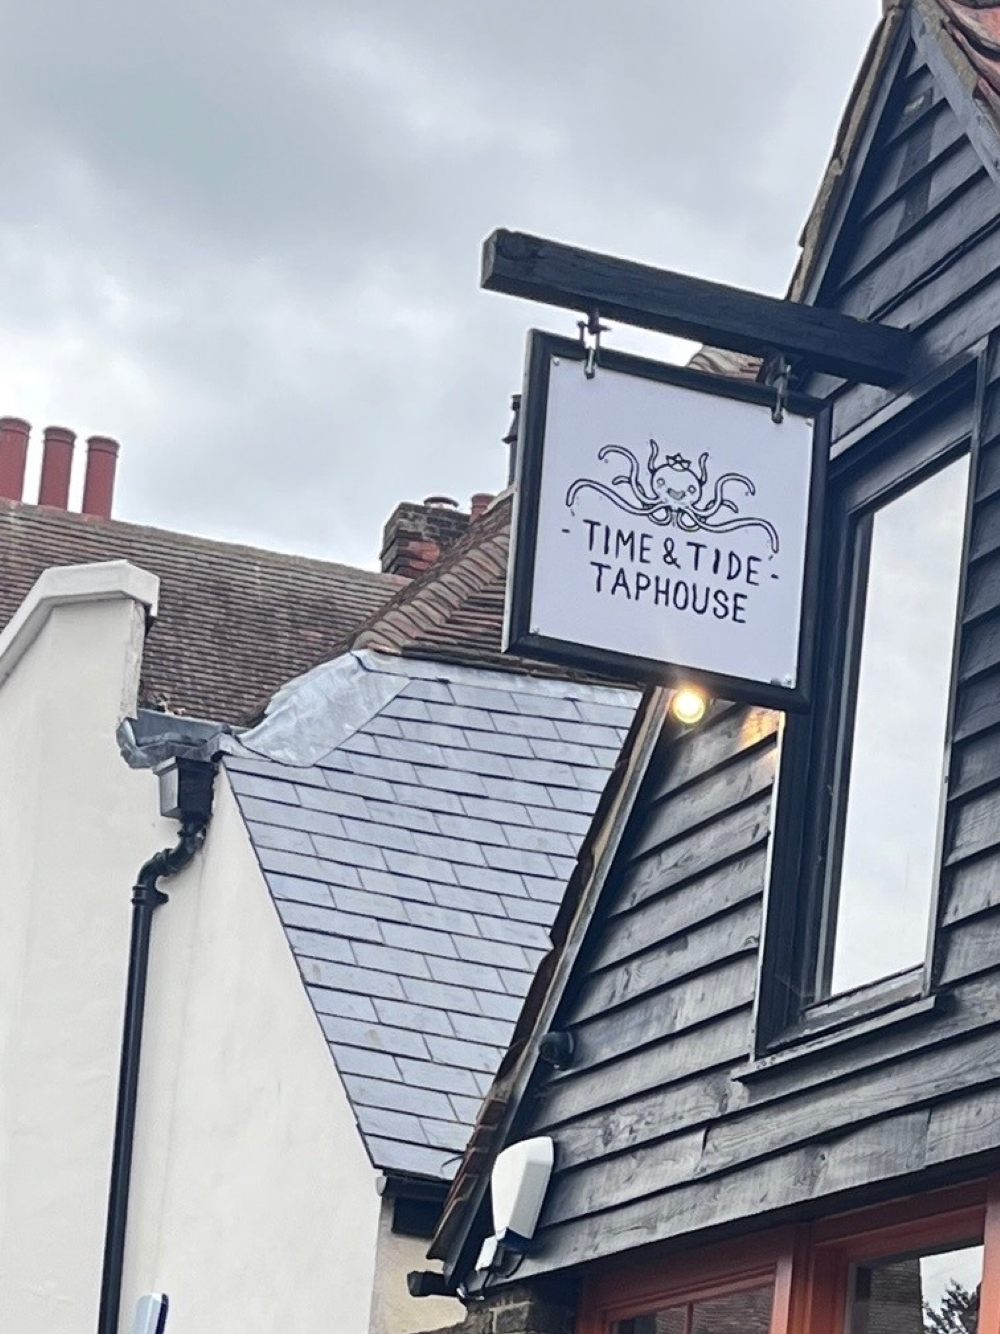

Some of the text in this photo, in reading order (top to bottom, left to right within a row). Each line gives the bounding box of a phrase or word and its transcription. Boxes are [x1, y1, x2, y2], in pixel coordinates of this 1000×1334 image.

[583, 519, 763, 586] TIME & TIDE
[590, 561, 748, 624] TAPHOUSE
